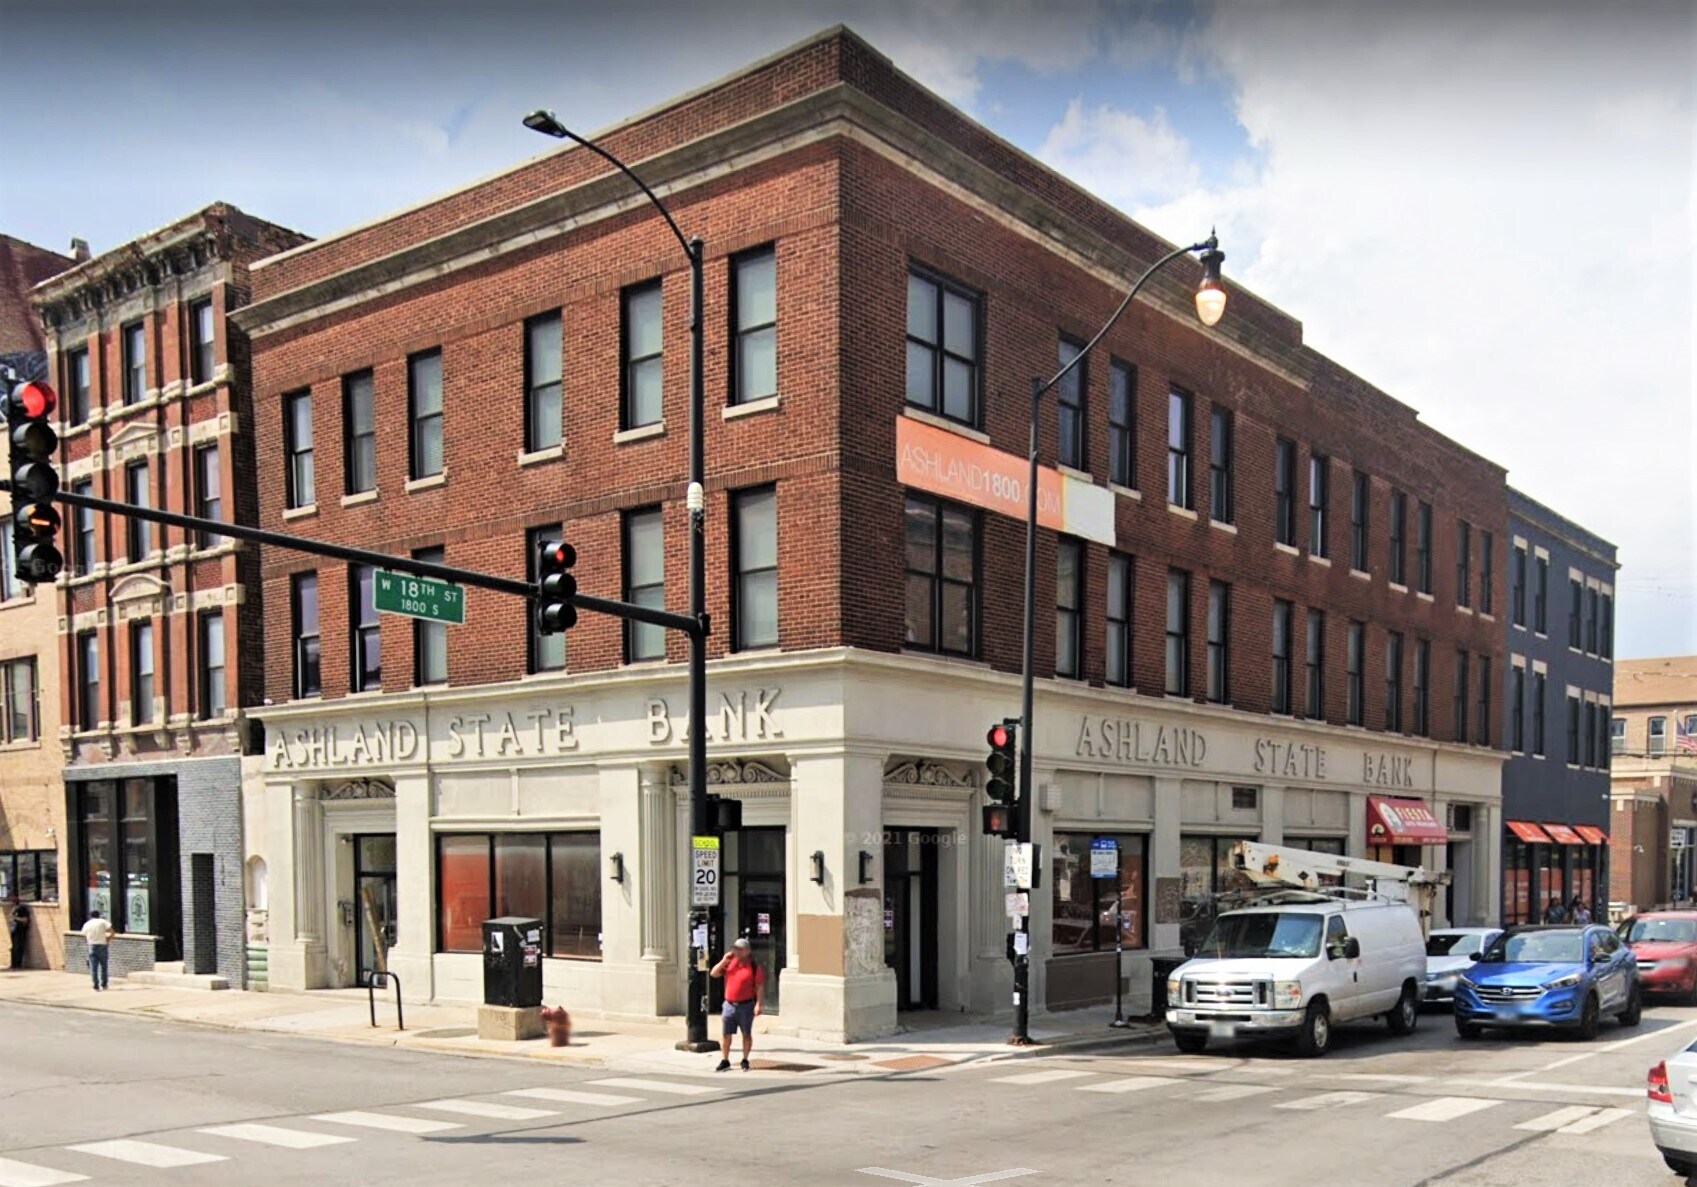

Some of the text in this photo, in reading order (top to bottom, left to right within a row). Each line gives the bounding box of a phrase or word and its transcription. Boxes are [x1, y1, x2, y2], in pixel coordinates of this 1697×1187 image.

[382, 579, 458, 603] W 18TH ST
[401, 599, 439, 615] 1800 S
[273, 720, 418, 768] ASHLAND
[449, 705, 578, 757] STATE
[1075, 716, 1413, 787] ASHLAND STATE BANK
[1394, 807, 1434, 821] FIESTA
[695, 850, 717, 859] SPEED
[696, 869, 716, 884] 20
